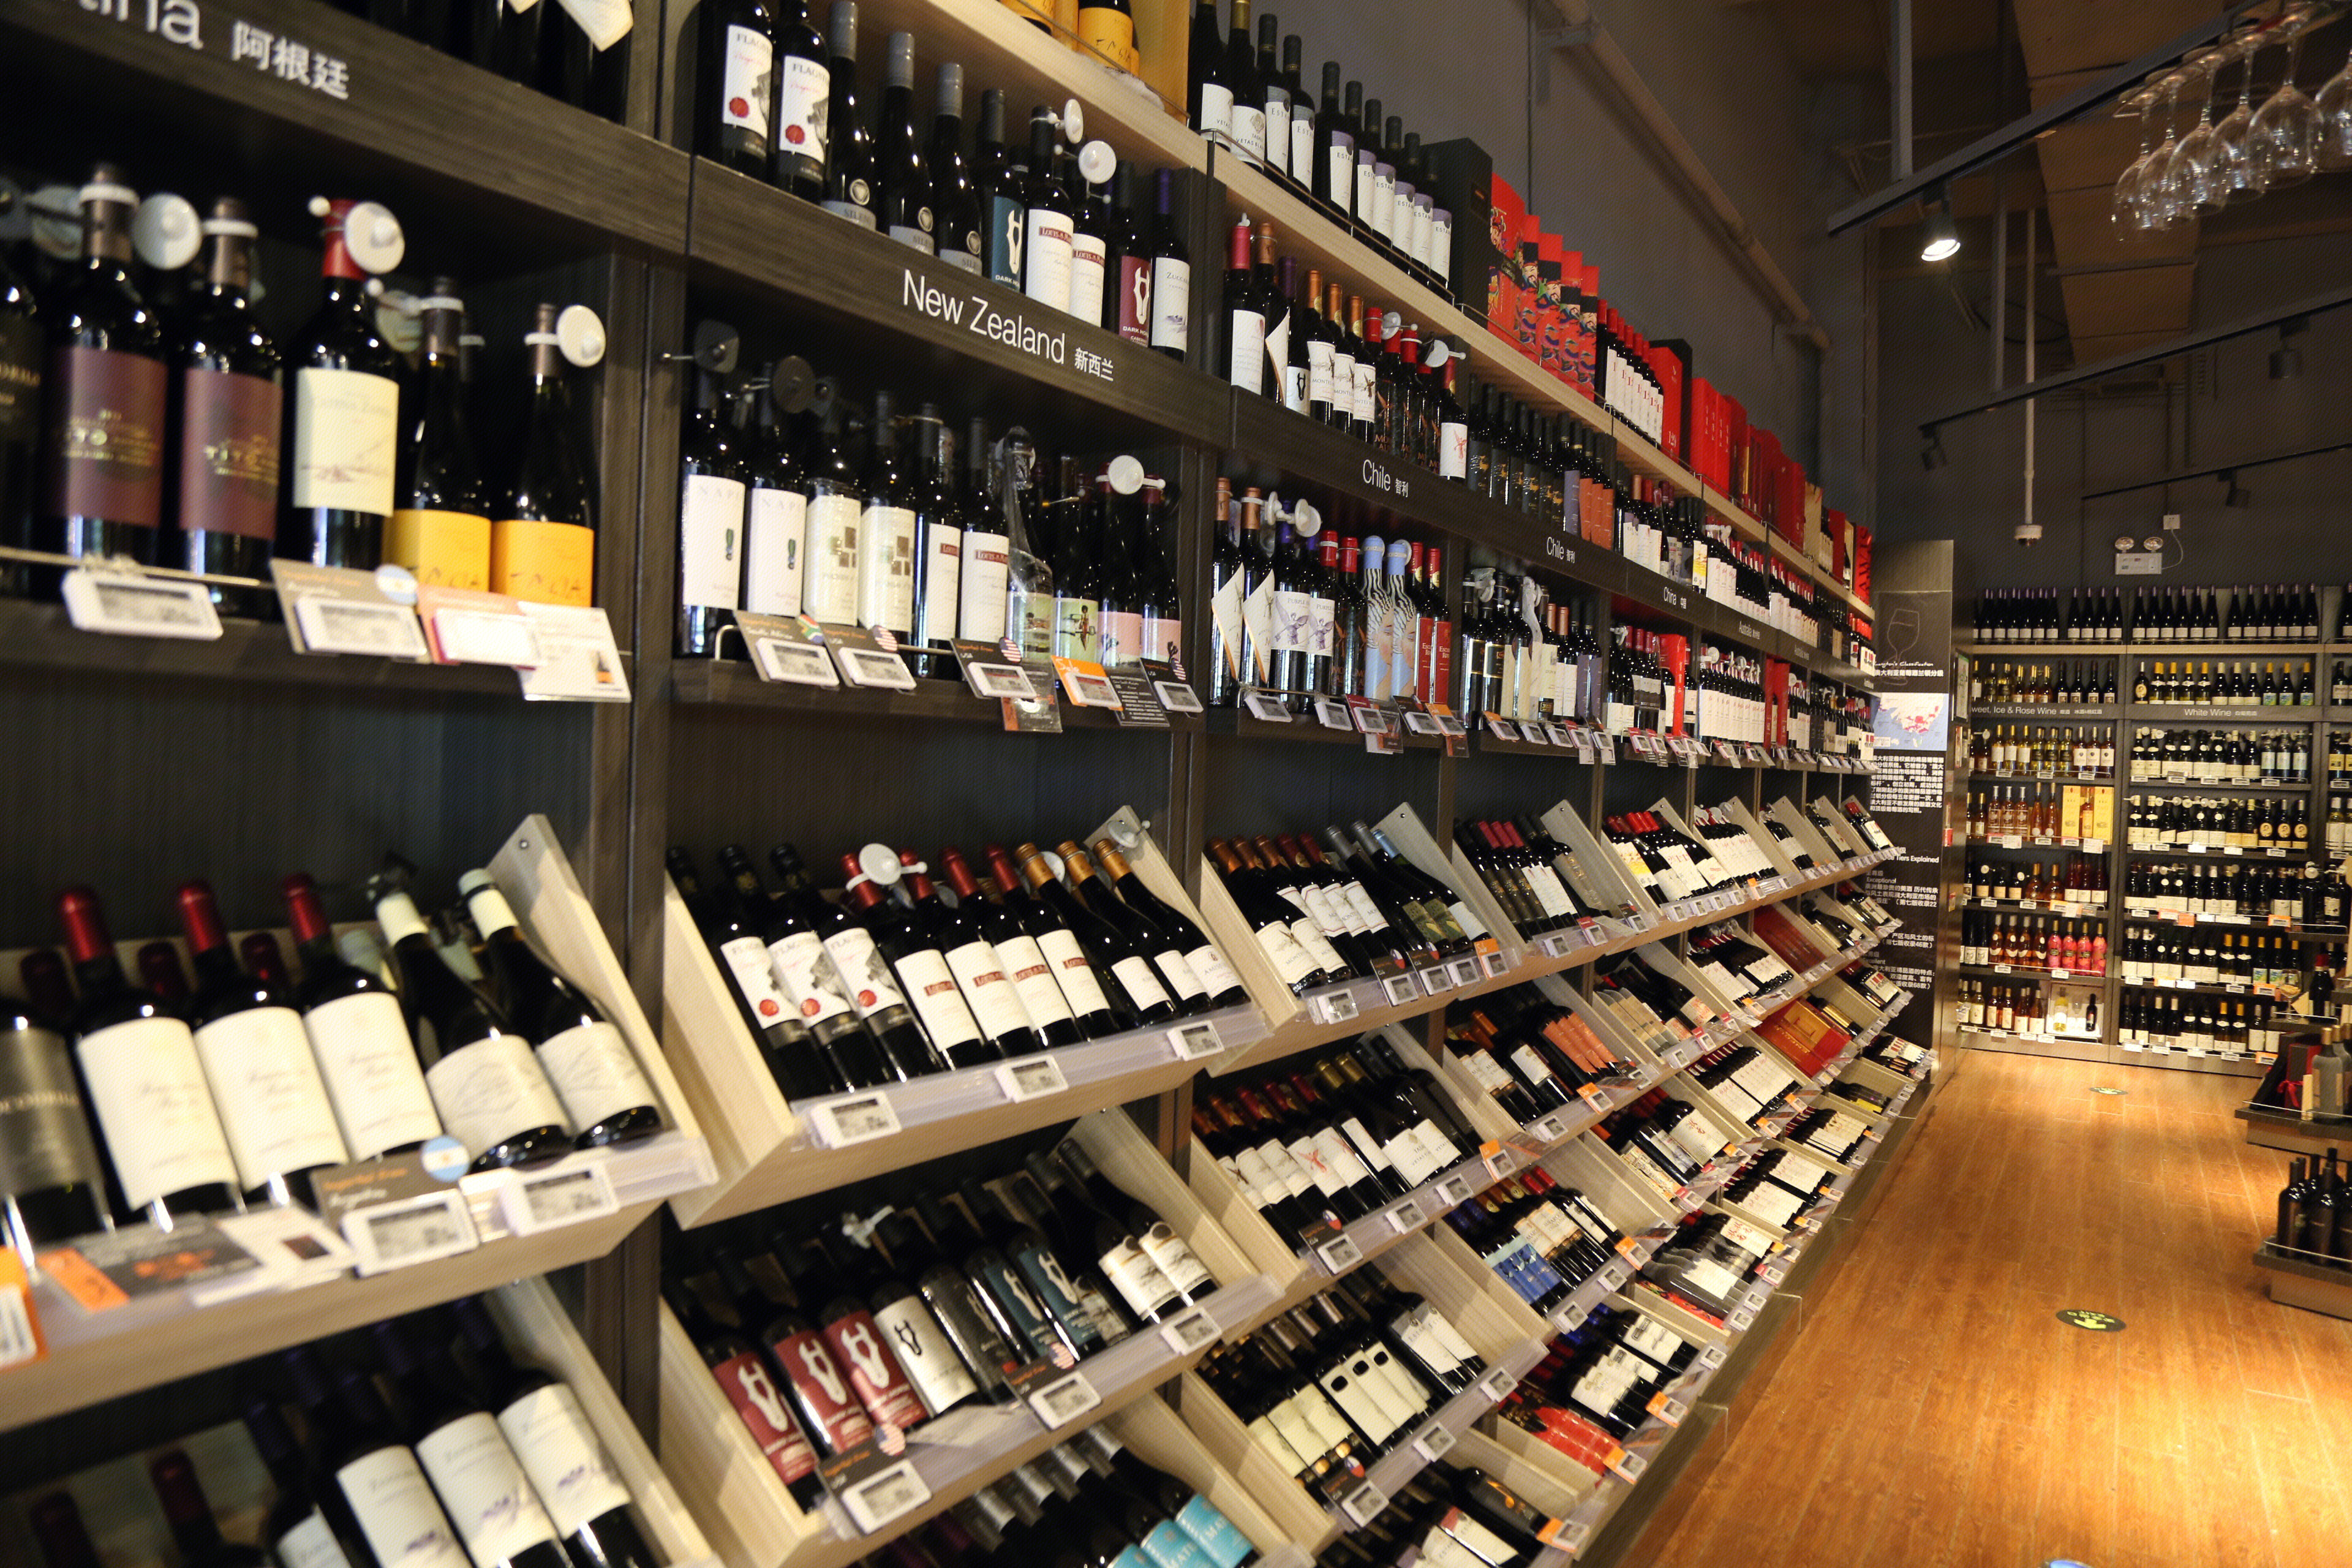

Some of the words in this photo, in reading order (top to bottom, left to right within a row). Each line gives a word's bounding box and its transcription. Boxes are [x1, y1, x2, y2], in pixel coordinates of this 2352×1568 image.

[232, 20, 350, 100] 阿根廷
[995, 274, 1012, 284] DARK
[903, 270, 963, 325] New
[970, 296, 1065, 365] Zealand
[1074, 347, 1114, 382] 新西兰
[1363, 459, 1391, 492] Chile
[1395, 478, 1409, 498] 智利
[1547, 537, 1564, 560] Chile
[1566, 549, 1575, 564] 智利
[1664, 586, 1676, 605] China
